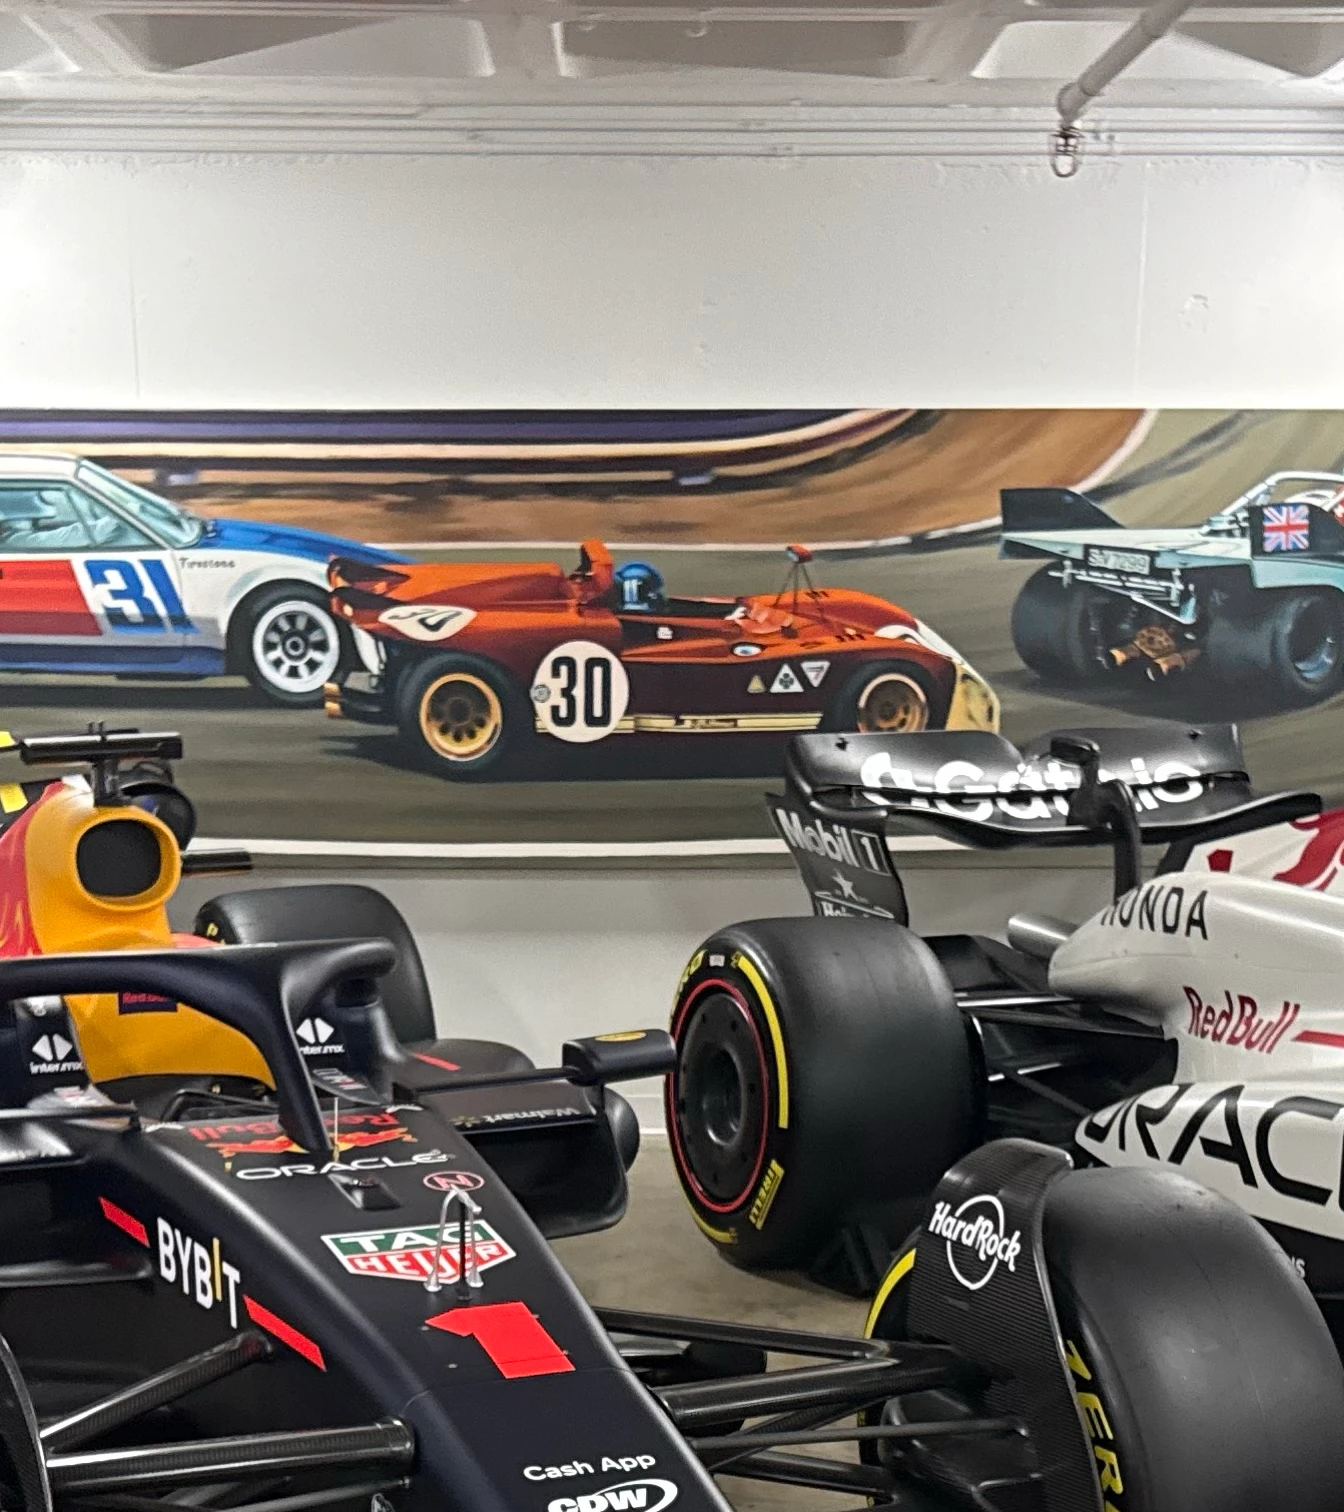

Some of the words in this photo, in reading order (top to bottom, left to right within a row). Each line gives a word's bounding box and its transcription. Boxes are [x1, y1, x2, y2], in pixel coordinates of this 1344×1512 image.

[83, 559, 199, 635] 31
[549, 655, 613, 729] 30
[775, 808, 859, 868] Mobil
[1100, 884, 1210, 940] HONDA
[236, 1150, 450, 1181] ORACLE
[340, 1224, 491, 1254] TAG
[353, 1242, 507, 1280] HEUER
[156, 1216, 242, 1330] BYBIT
[425, 1301, 577, 1380] 1
[523, 1459, 594, 1482] Cash
[600, 1453, 656, 1476] App
